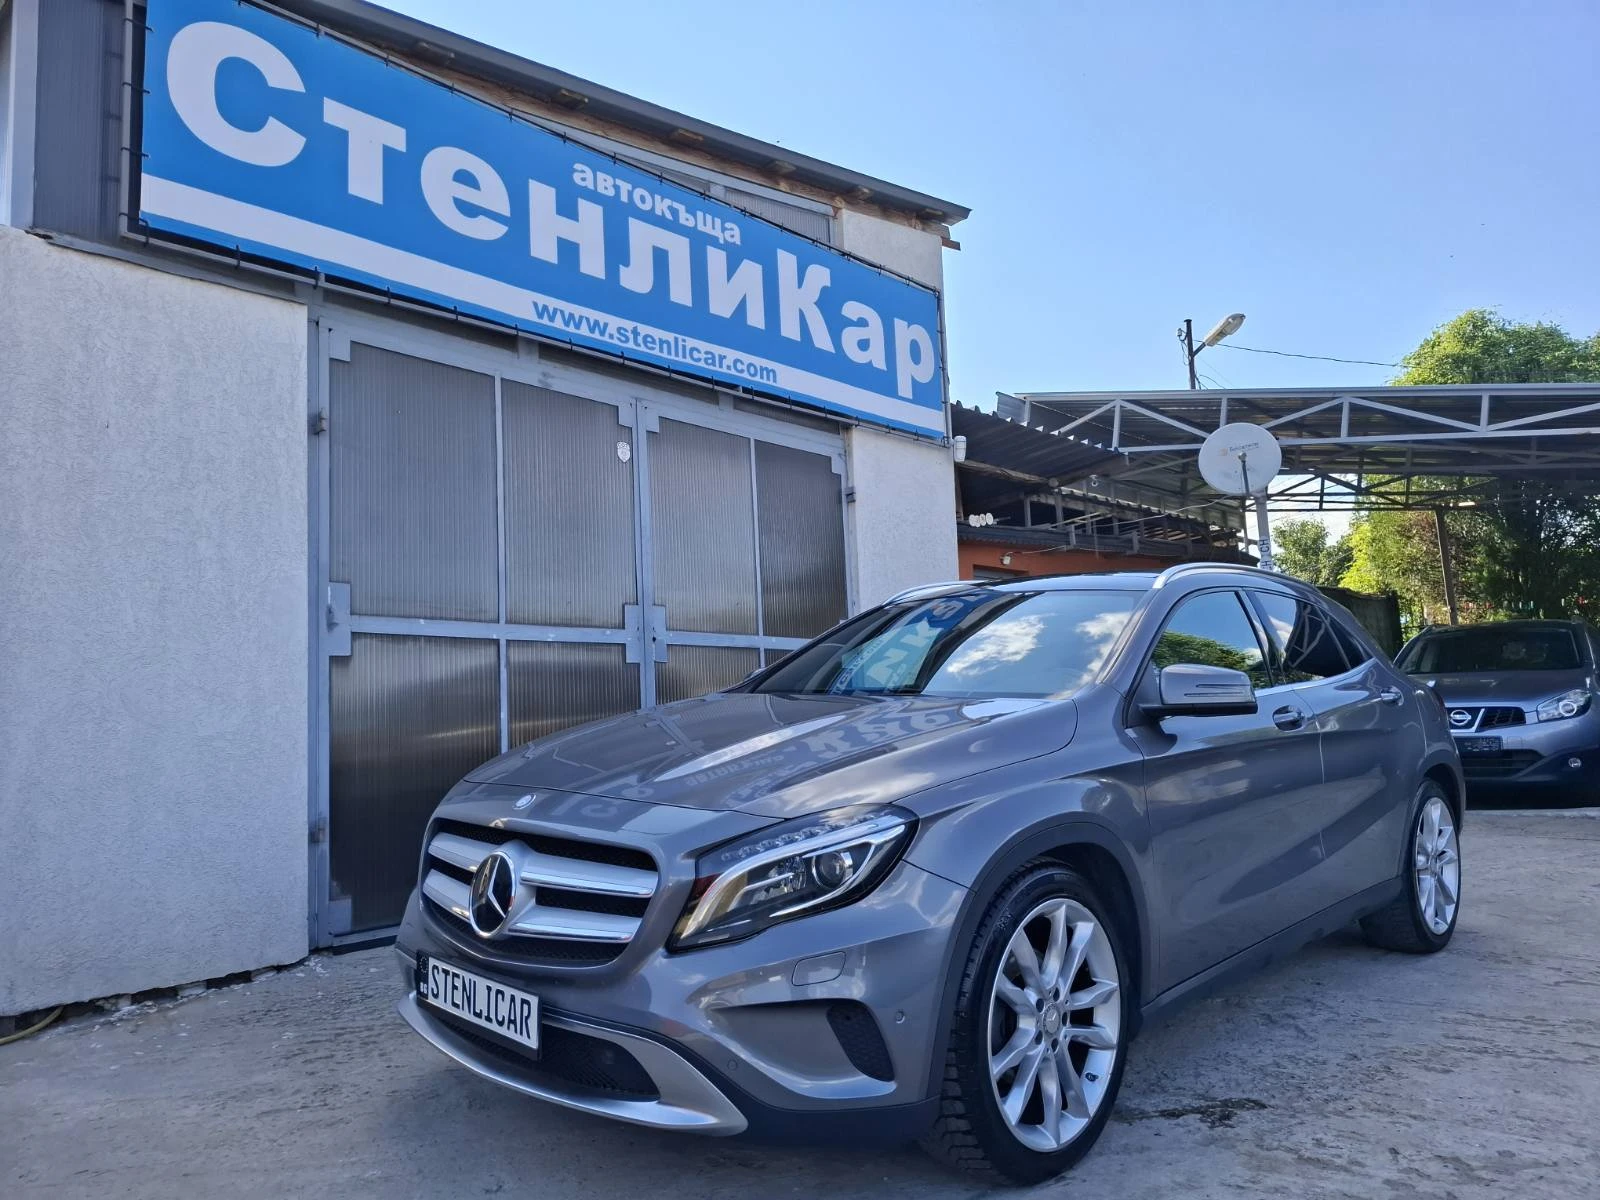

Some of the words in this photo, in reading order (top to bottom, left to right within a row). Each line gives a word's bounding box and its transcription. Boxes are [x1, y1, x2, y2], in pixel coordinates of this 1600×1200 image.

[166, 21, 935, 399] СтенлиКар
[572, 162, 742, 246] автокъща
[532, 300, 778, 384] www.stenlicar.com
[420, 982, 428, 995] BG
[431, 963, 532, 1040] STENLICAR
